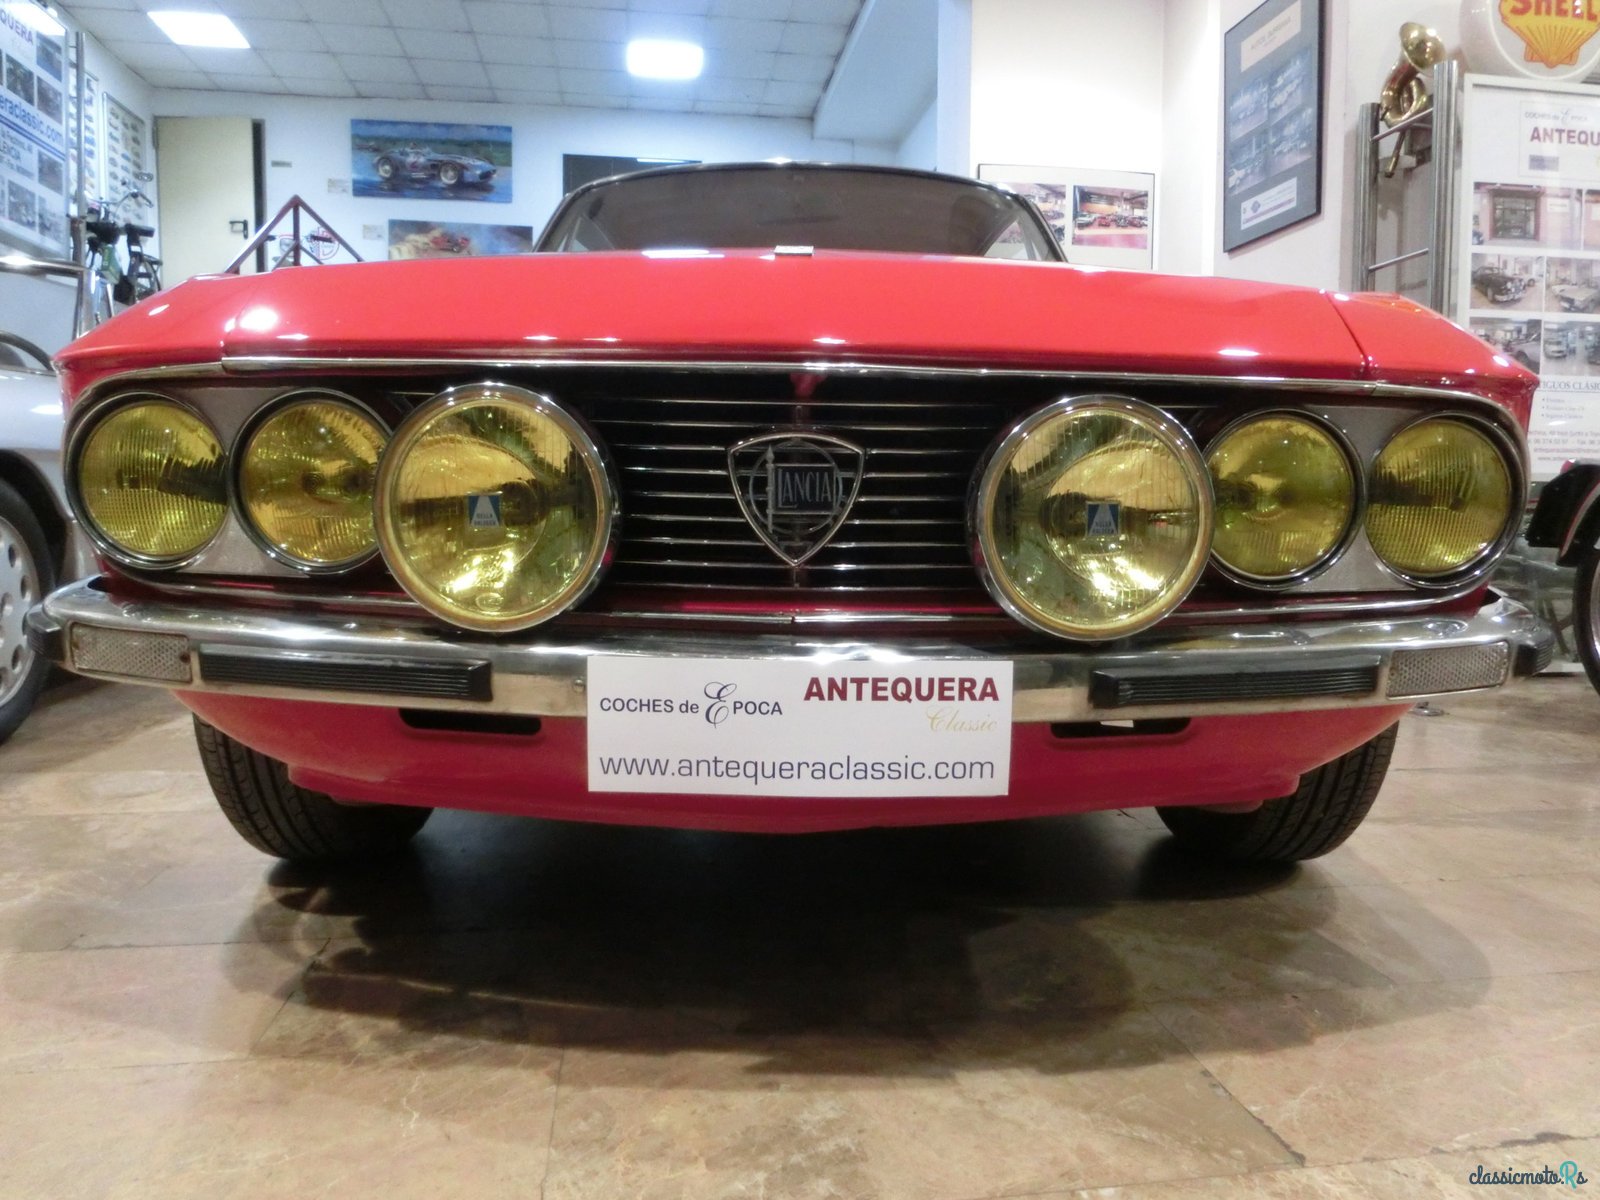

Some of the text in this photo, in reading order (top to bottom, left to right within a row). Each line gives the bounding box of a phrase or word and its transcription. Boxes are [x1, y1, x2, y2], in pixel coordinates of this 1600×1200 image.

[777, 468, 831, 509] LANCIA
[803, 677, 1000, 703] ANTEQUERA
[600, 697, 674, 713] COCHES
[679, 700, 699, 713] de
[926, 705, 998, 732] Classic
[599, 754, 995, 786] www.antequeraclassic.com
